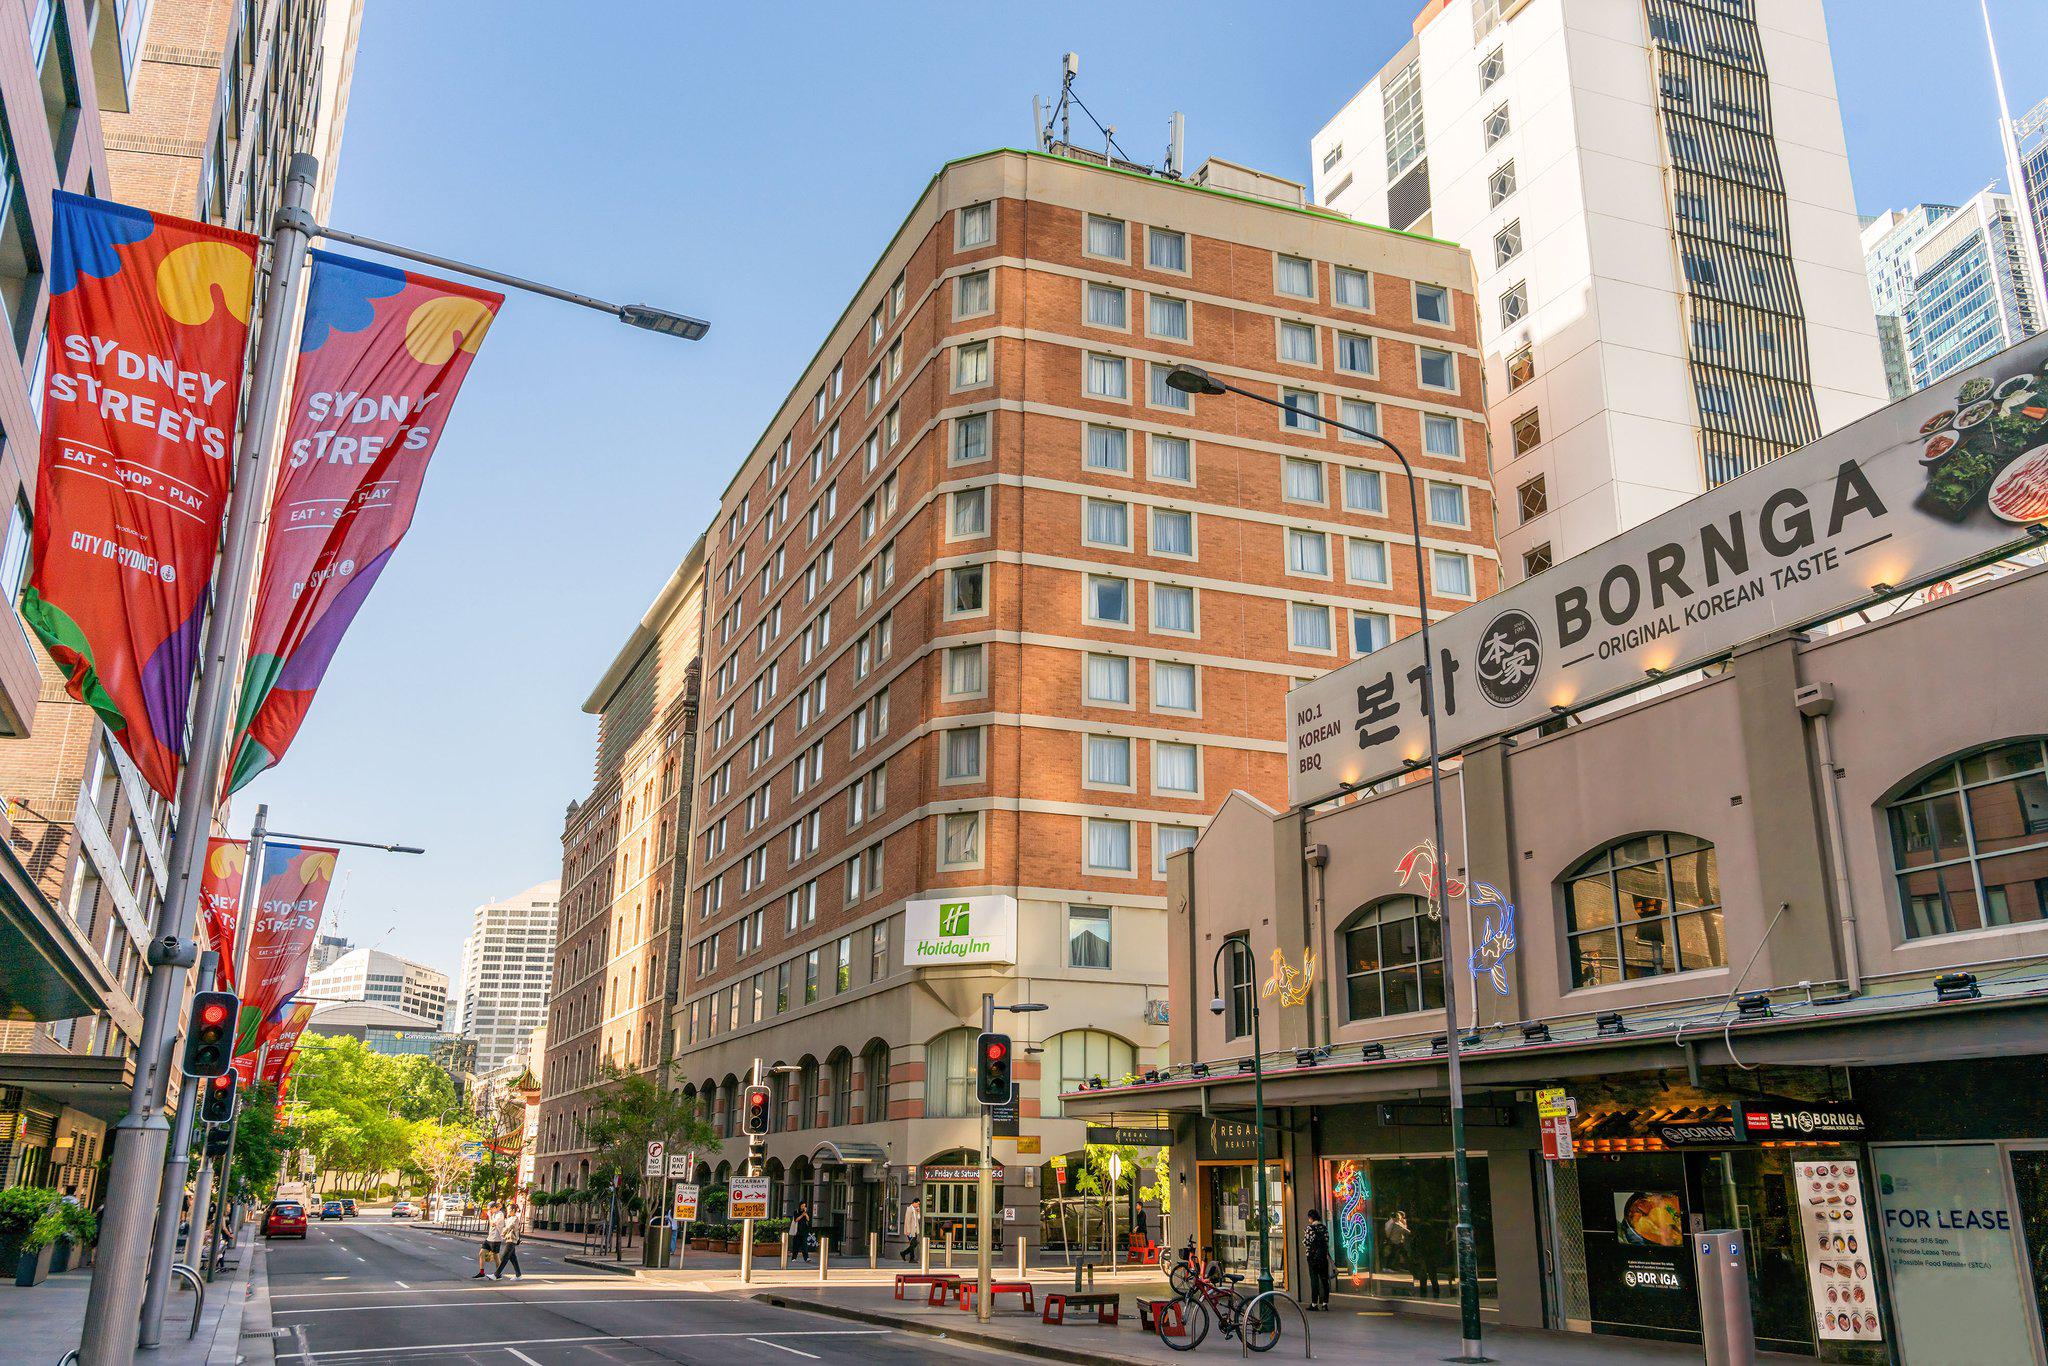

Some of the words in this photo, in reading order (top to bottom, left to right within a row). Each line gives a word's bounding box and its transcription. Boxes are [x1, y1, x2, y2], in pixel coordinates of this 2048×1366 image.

[64, 334, 227, 406] SYDNEY
[50, 373, 226, 460] STREETS
[308, 391, 440, 424] SYDNY
[289, 425, 431, 469] STRETS
[63, 447, 97, 466] EAT
[169, 486, 203, 511] PLAY
[290, 508, 316, 522] EAT
[71, 530, 102, 555] CITY
[102, 539, 118, 560] OF
[117, 546, 160, 576] SYDNEY
[1554, 458, 1889, 650] BORNGA
[1598, 613, 1681, 661] ORIGINAL
[1683, 577, 1765, 624] KOREAN
[1769, 546, 1839, 591] TASTE
[1481, 632, 1535, 686] 本家
[1354, 648, 1460, 750] 본가
[1297, 703, 1323, 726] NO.1
[1298, 719, 1341, 750] KOREAN
[1299, 753, 1322, 774] BBQ
[256, 915, 316, 933] STREETS
[917, 940, 967, 958] Holiday
[969, 938, 991, 953] Inn
[1220, 1124, 1259, 1136] REGAL
[1812, 1113, 1865, 1126] BORNGA
[1225, 1140, 1256, 1149] REALTY
[934, 1170, 953, 1178] Friday
[961, 1170, 980, 1178] Saturd
[1884, 1209, 1931, 1229] FOR
[1937, 1209, 2011, 1231] LEASE
[1941, 1249, 1960, 1257] Terms
[1637, 1271, 1679, 1286] BORNGA
